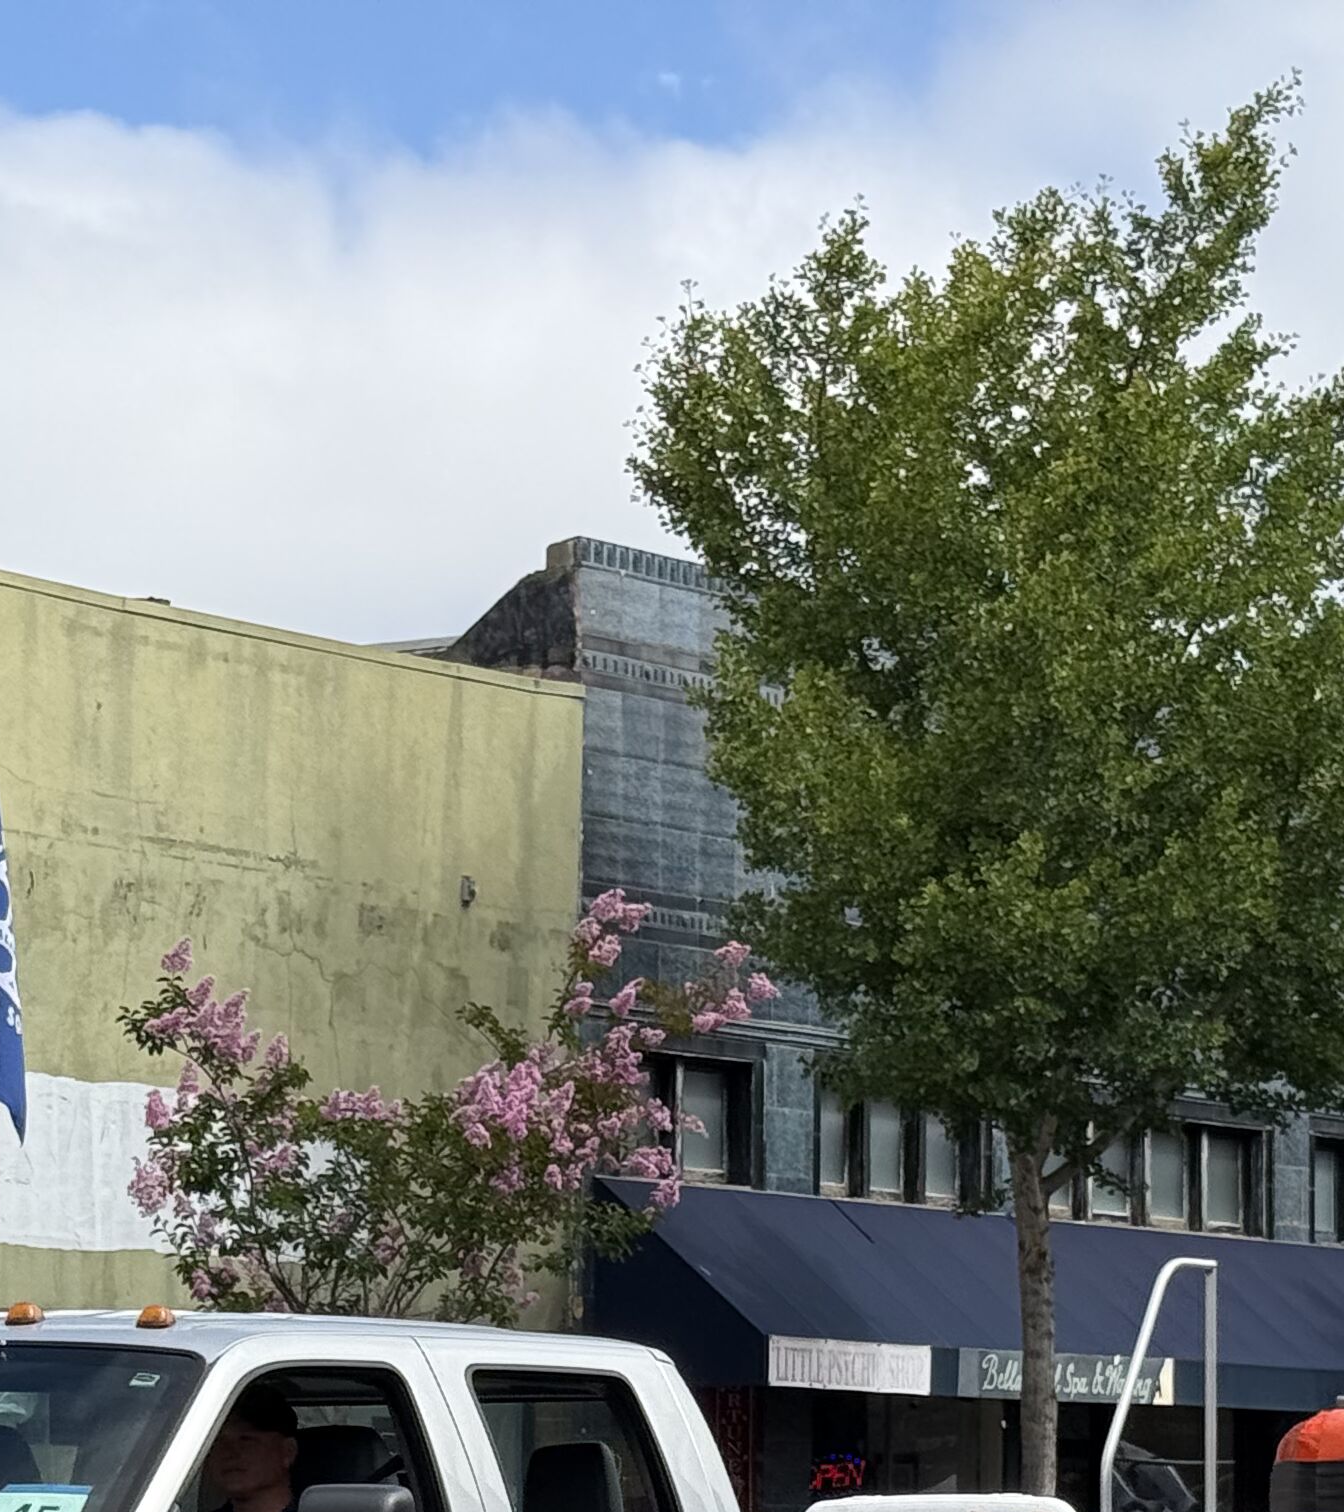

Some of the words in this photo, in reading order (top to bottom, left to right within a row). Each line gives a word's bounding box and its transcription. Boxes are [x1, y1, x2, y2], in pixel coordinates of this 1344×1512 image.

[774, 1346, 824, 1383] LITTLE
[888, 1353, 928, 1391] SHOP
[1063, 1362, 1088, 1400] Spa
[1092, 1361, 1105, 1394] &
